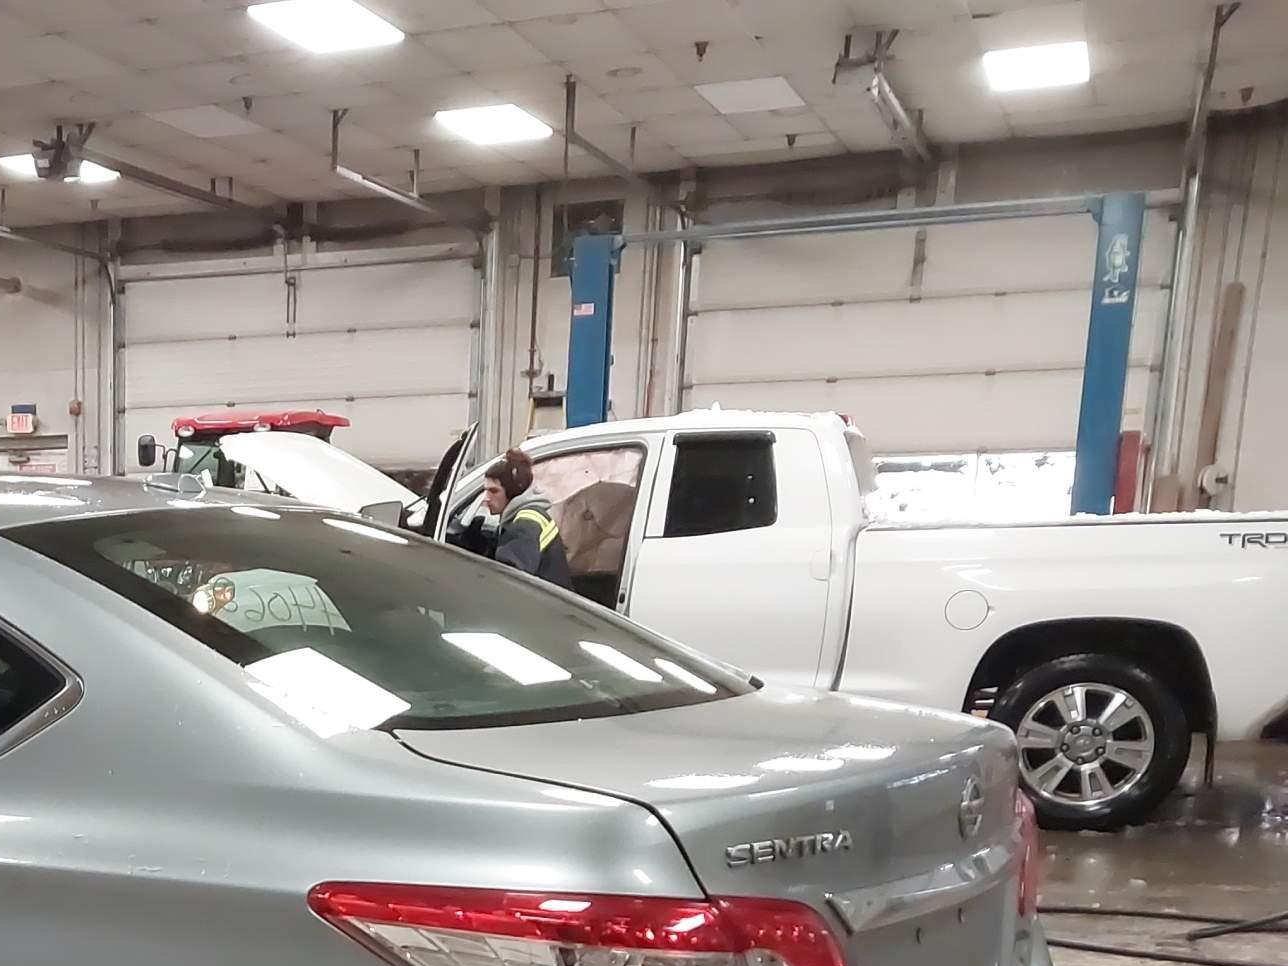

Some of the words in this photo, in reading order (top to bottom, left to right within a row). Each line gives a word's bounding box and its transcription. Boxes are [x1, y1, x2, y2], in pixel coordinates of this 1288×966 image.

[11, 414, 30, 431] EXIT
[1219, 532, 1288, 549] TRD
[725, 829, 852, 868] SENTRA
